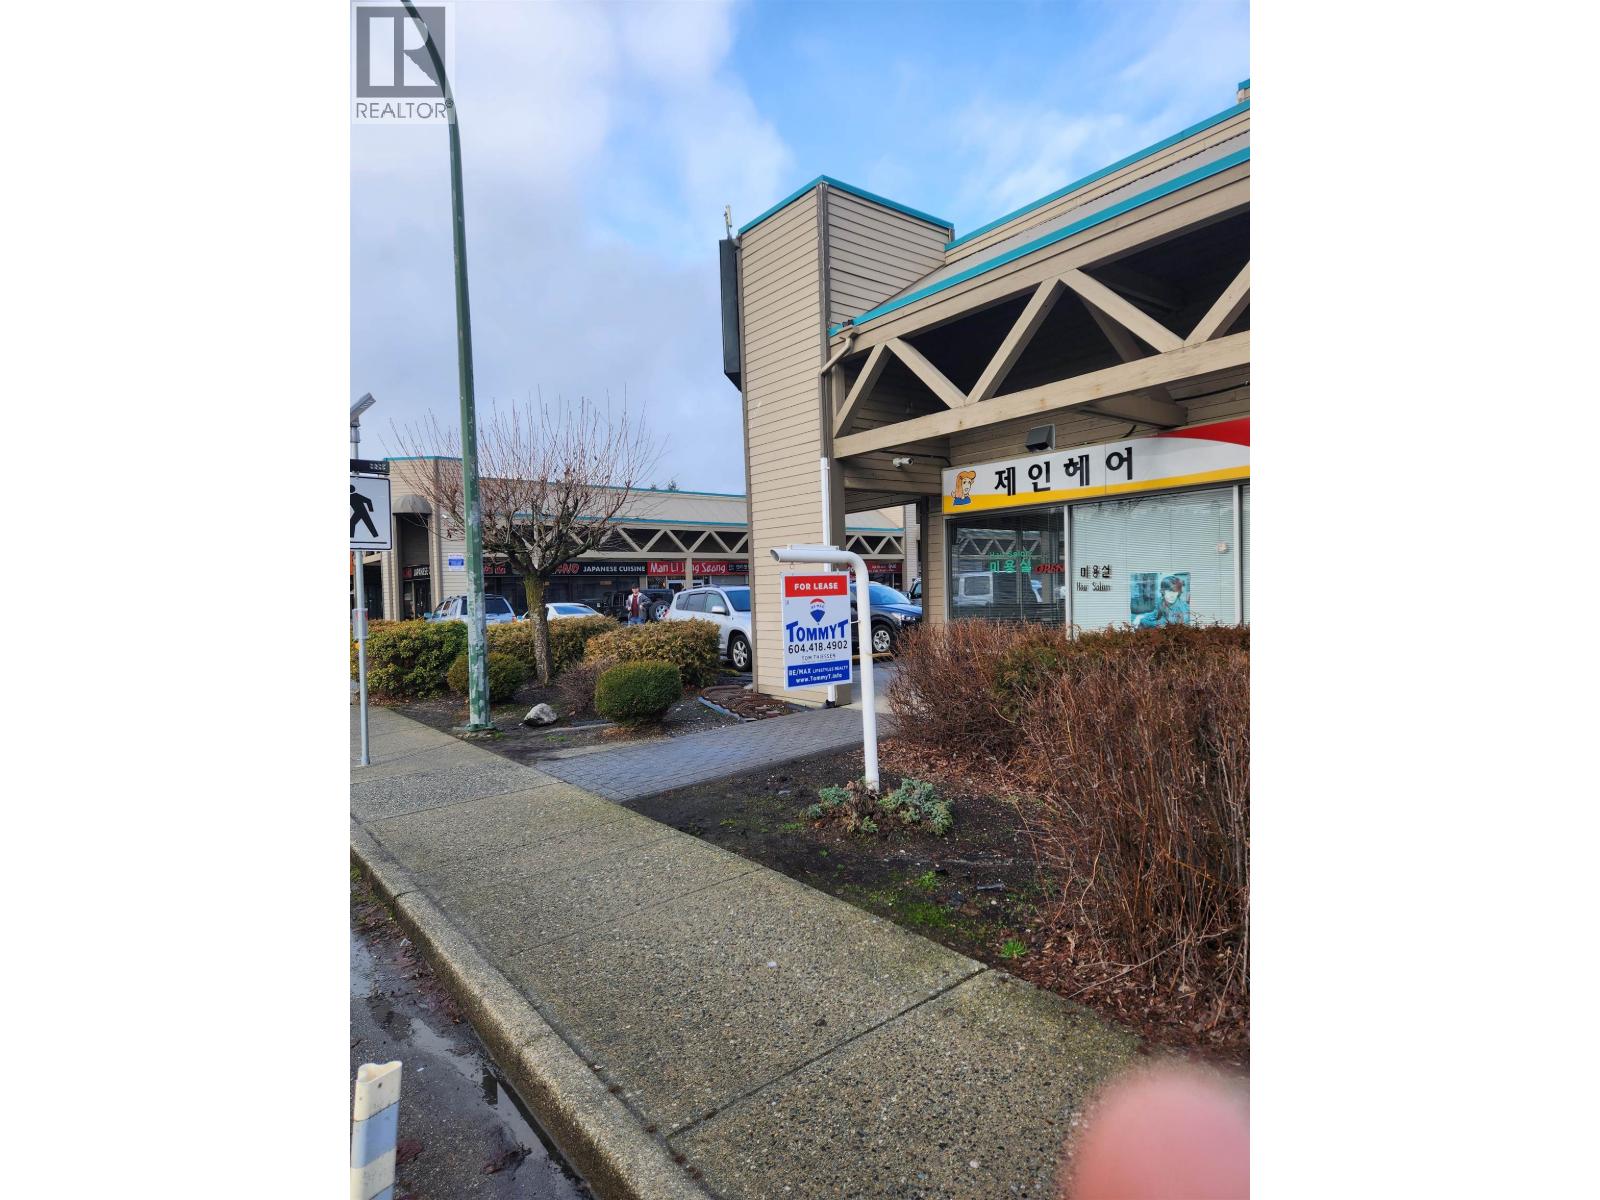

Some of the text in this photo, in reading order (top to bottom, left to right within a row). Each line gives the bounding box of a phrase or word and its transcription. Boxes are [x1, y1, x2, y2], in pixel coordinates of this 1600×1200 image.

[582, 565, 618, 573] JAPANESE
[650, 562, 669, 573] Man
[794, 582, 838, 591] FOR LEASE
[788, 640, 848, 654] 604.418.4902
[788, 668, 811, 676] RE/MAX
